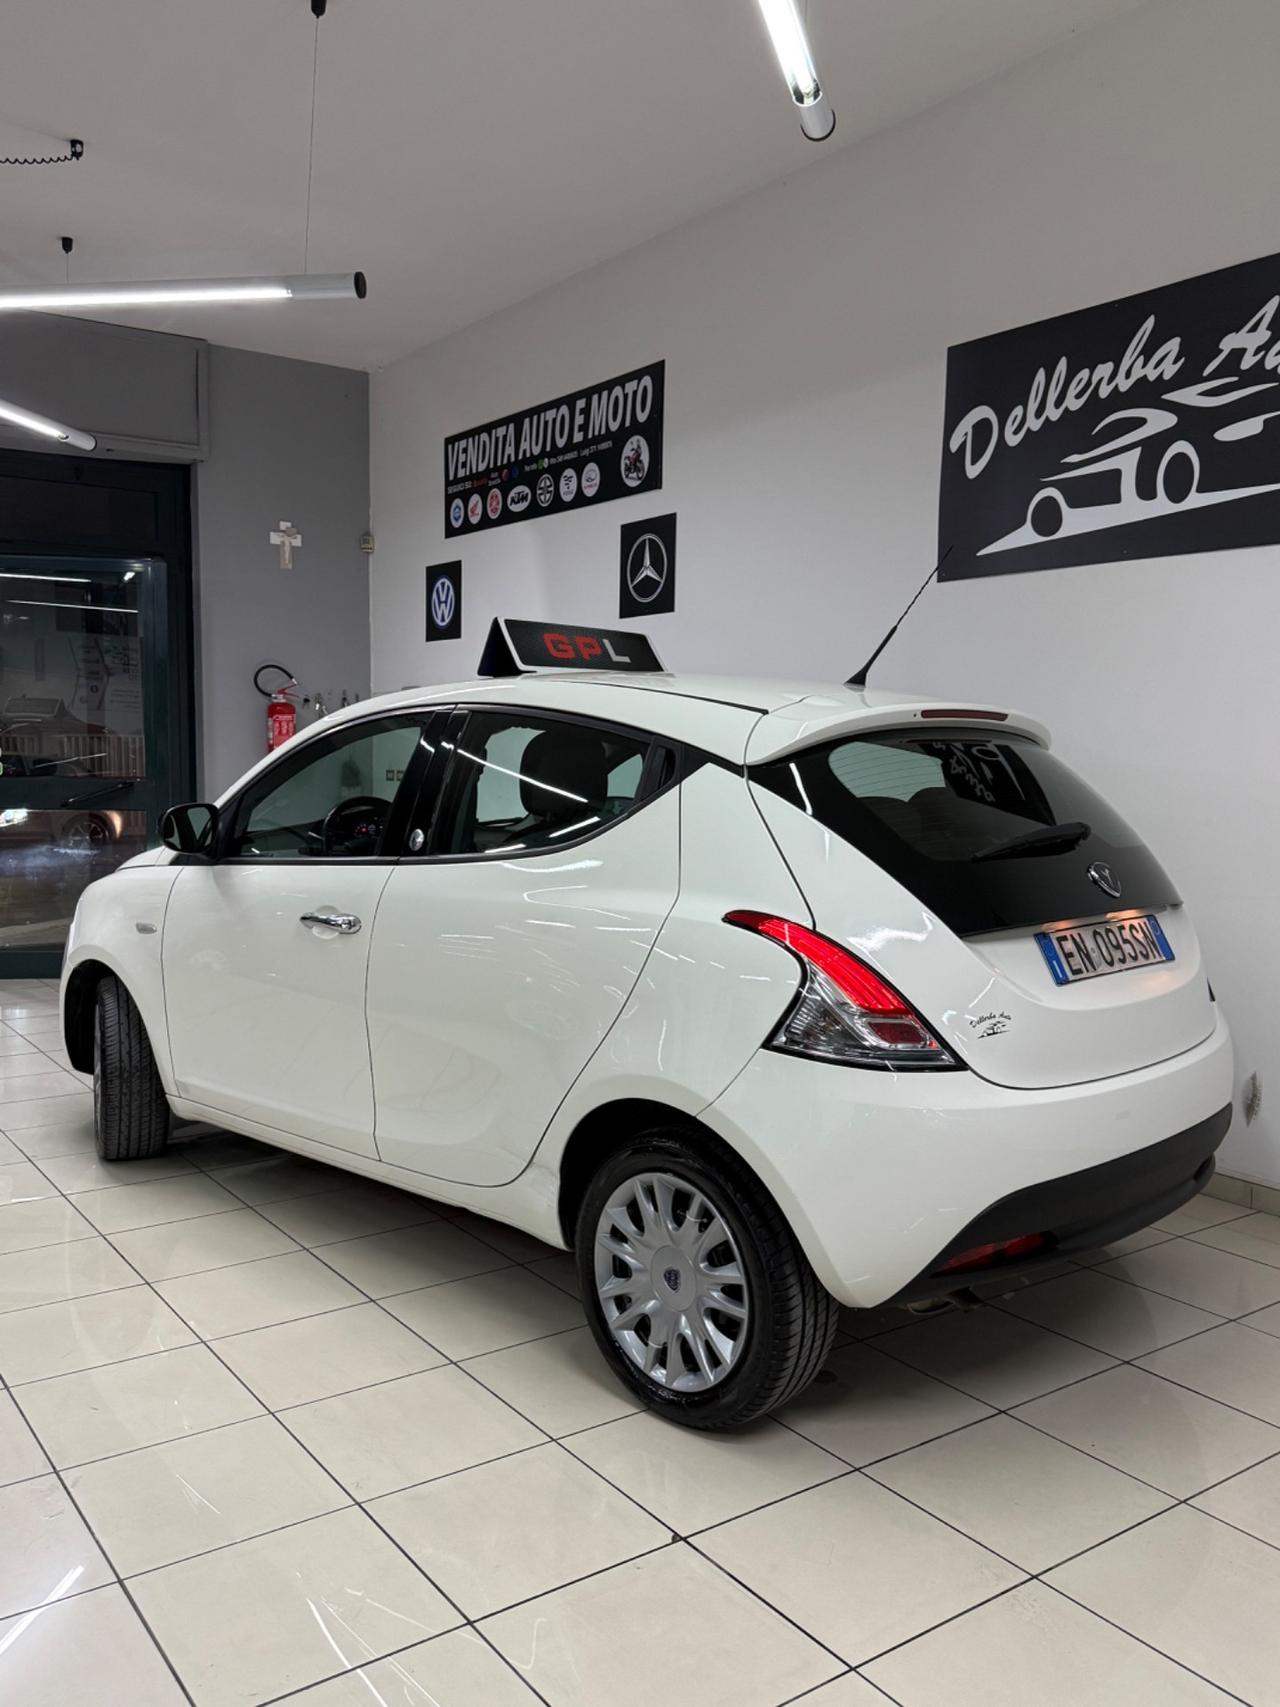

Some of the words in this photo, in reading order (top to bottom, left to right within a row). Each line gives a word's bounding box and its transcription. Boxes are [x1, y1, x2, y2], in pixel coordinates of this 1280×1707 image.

[949, 314, 1185, 480] Dellerba
[447, 423, 515, 481] VENDITA
[518, 404, 570, 460] AUTO
[572, 398, 587, 444] E
[588, 375, 653, 439] MOTO
[509, 490, 529, 506] KTM
[543, 633, 632, 663] GPL
[1056, 932, 1097, 976] EN
[1092, 920, 1164, 968] 095SN
